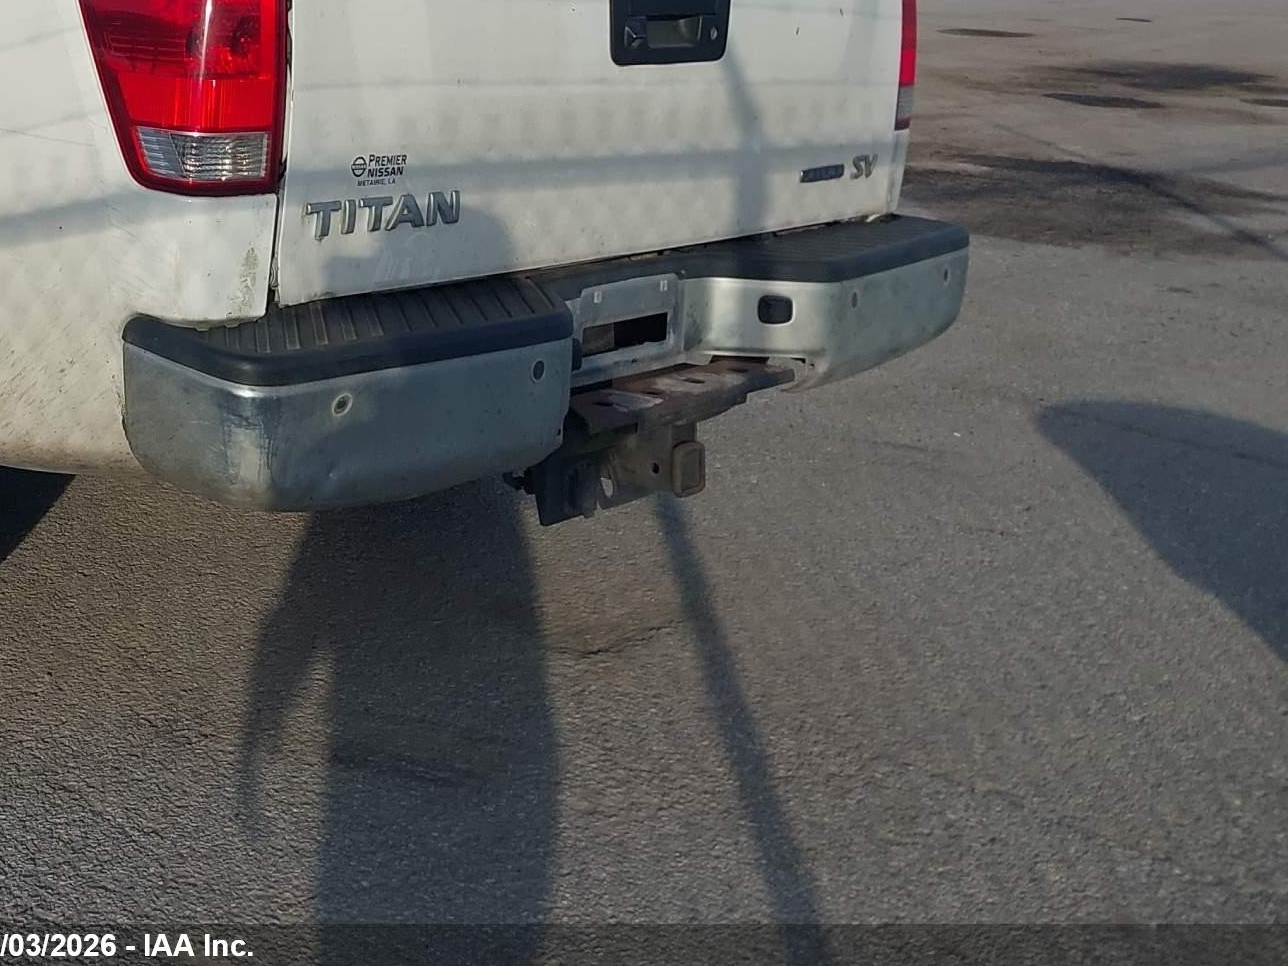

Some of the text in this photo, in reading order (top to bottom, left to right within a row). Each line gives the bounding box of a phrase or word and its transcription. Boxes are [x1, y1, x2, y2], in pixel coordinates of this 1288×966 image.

[368, 154, 408, 167] PREMIER
[367, 166, 404, 179] NISSAN
[306, 189, 462, 240] TITAN
